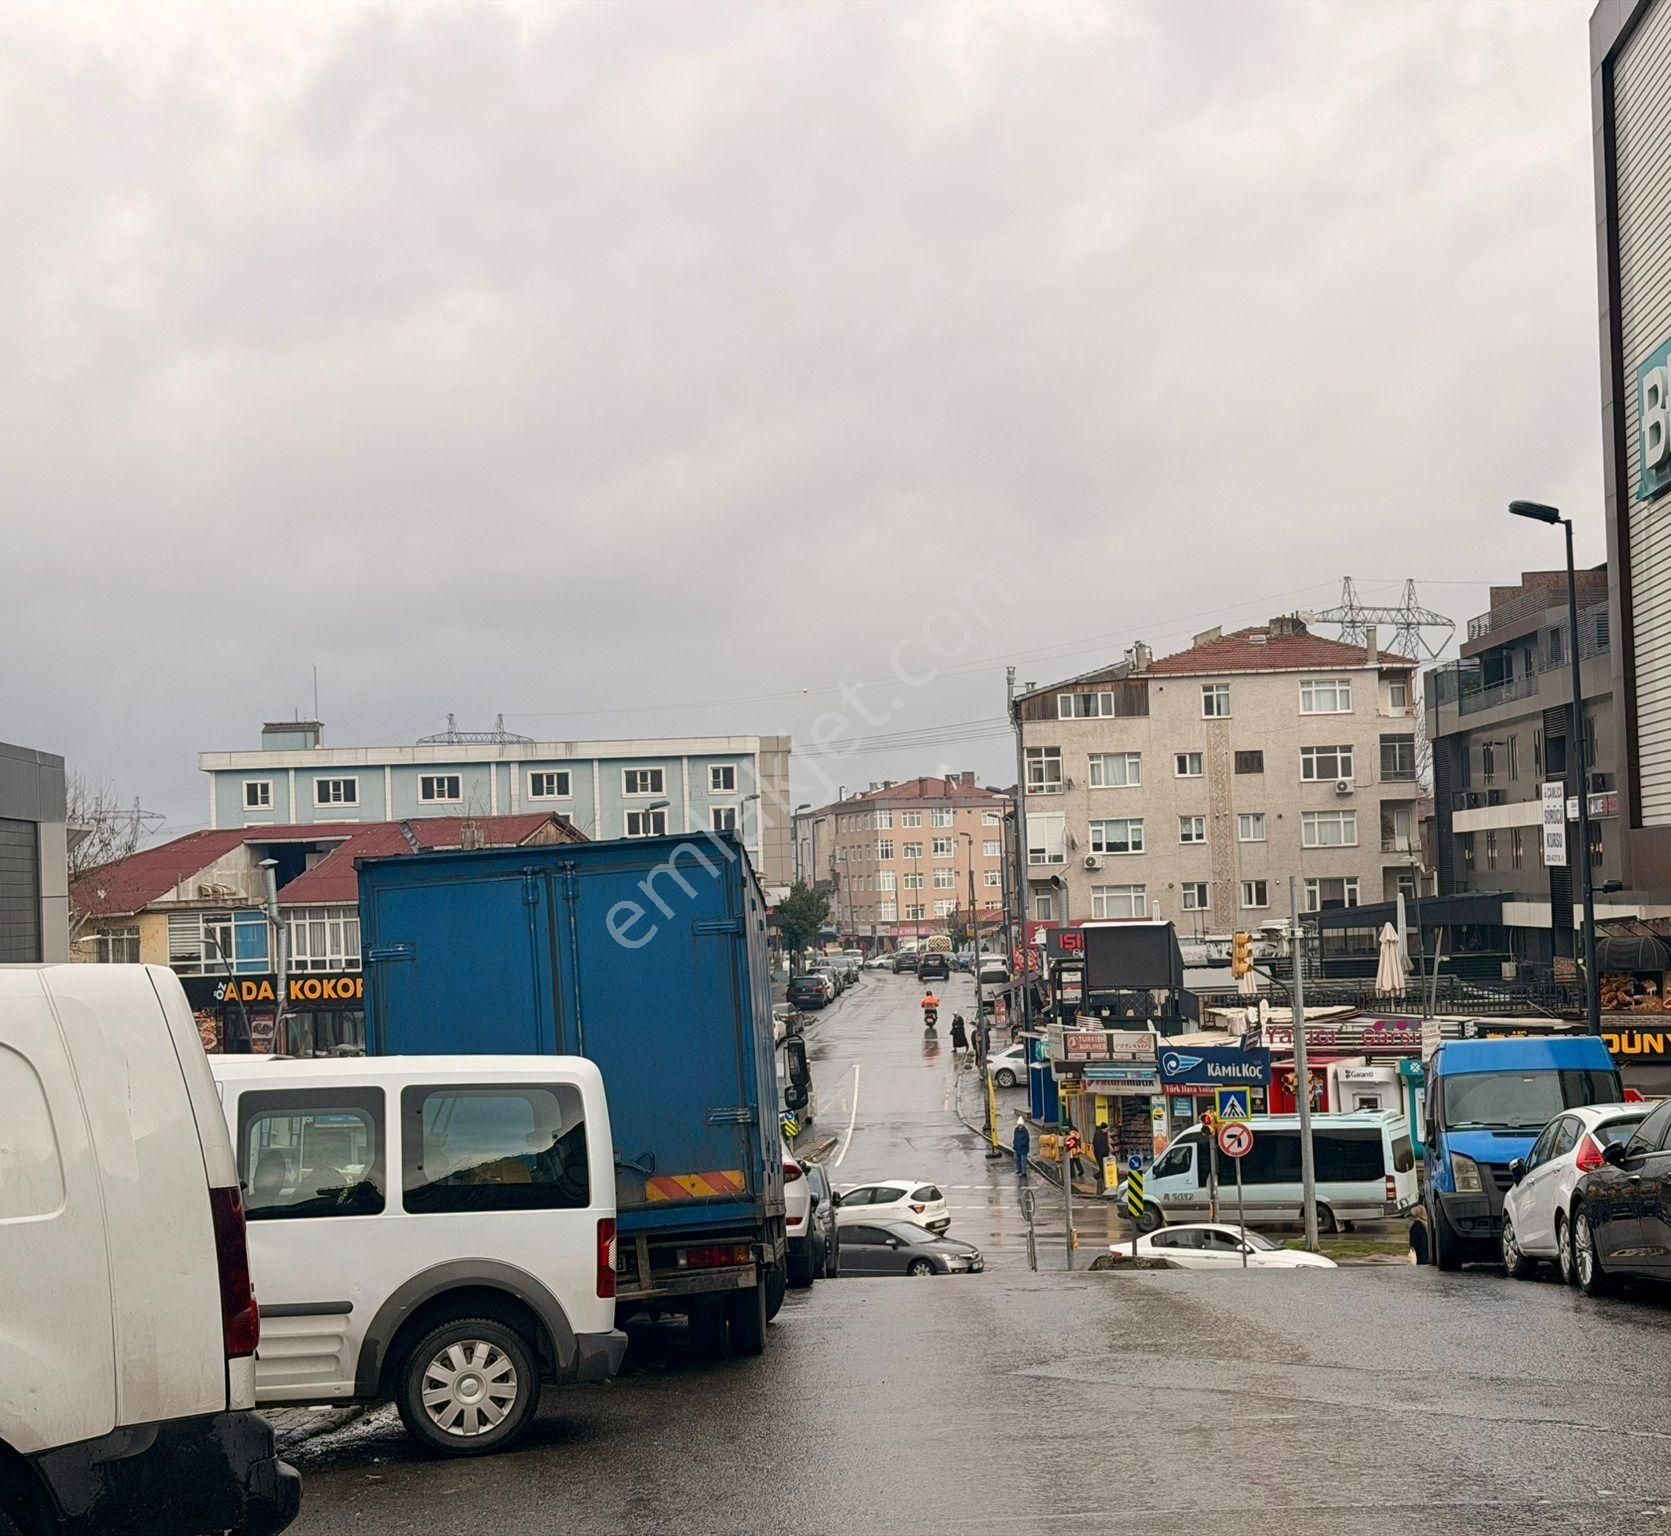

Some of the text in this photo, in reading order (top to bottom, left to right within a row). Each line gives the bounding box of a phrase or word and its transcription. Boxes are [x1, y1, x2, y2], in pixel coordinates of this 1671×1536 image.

[1642, 353, 1671, 470] B
[213, 981, 227, 1000] ÖZ
[224, 980, 276, 1001] ADA
[1266, 1024, 1337, 1045] Yaıcı
[1350, 1070, 1374, 1078] Garanti
[1165, 1084, 1181, 1093] Türk
